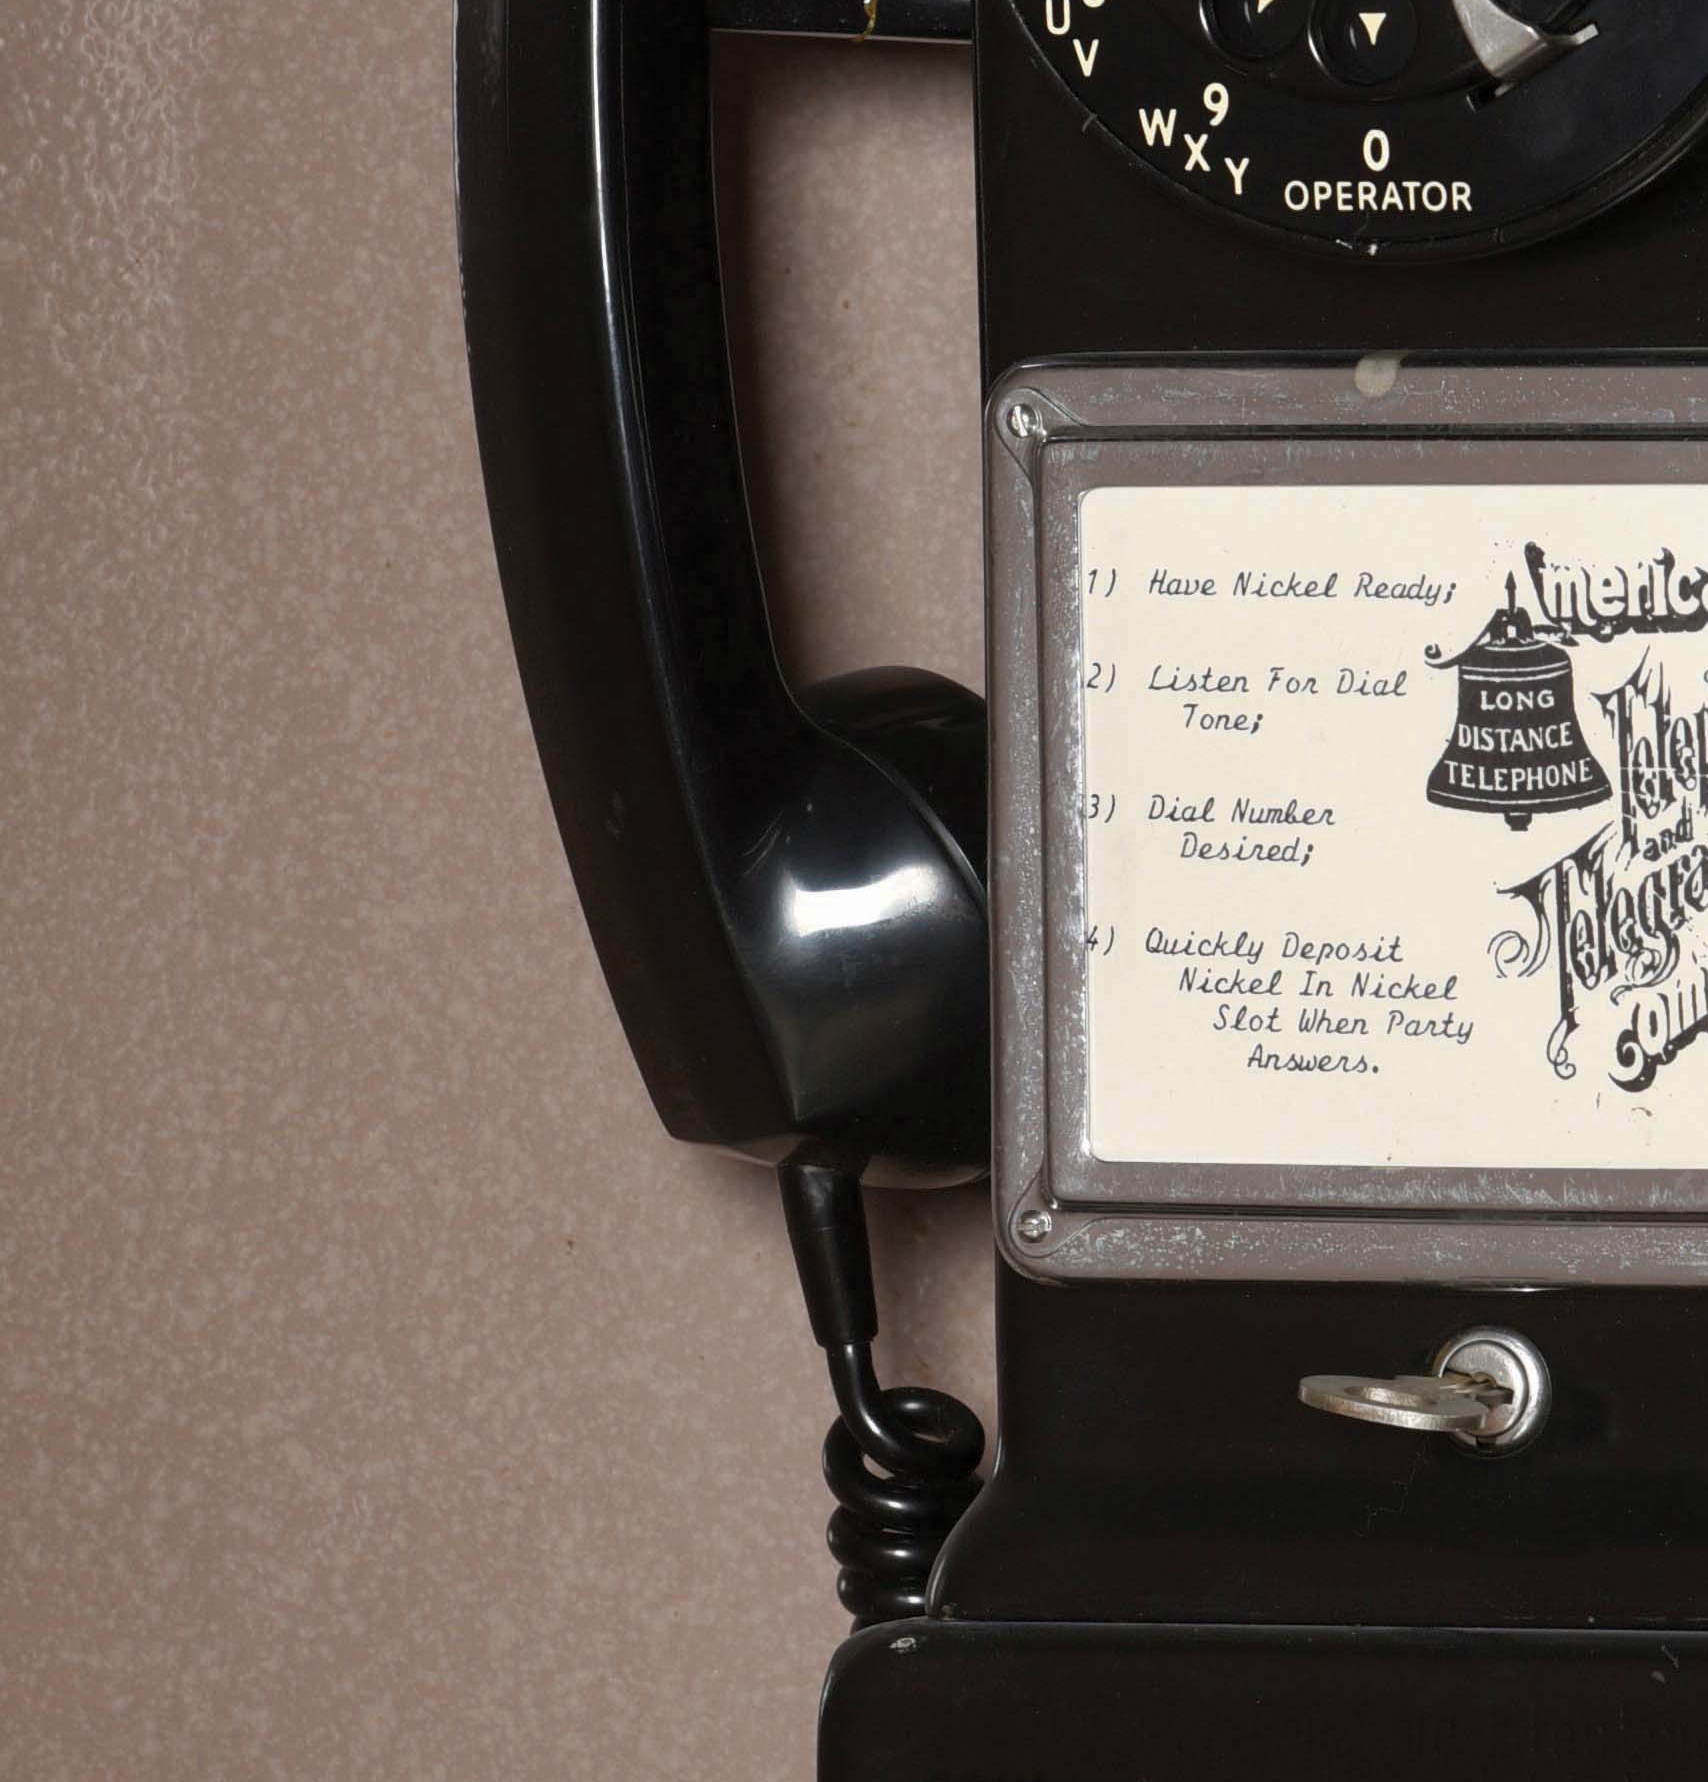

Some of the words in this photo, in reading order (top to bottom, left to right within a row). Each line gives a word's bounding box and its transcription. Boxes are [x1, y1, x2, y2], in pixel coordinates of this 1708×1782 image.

[1203, 82, 1229, 126] 9
[1284, 180, 1473, 212] OPERATOR
[1087, 568, 1117, 598] 1)
[1148, 569, 1217, 596] Have
[1233, 571, 1338, 598] Nickel
[1354, 572, 1458, 607] Ready;
[1086, 662, 1117, 693] 2)
[1148, 665, 1250, 693] Listen
[1267, 667, 1319, 694] For
[1336, 668, 1408, 697] Dial
[1480, 689, 1555, 711] LONG
[1183, 703, 1264, 734] Tone;
[1457, 721, 1574, 753] DISTANCE
[1444, 756, 1594, 793] TELEPHONE
[1087, 793, 1117, 823] 3)
[1148, 794, 1215, 823] Dial
[1231, 797, 1336, 826] Number
[1642, 795, 1694, 862] and
[1180, 831, 1314, 867] Desired;
[1086, 925, 1115, 956] 4)
[1145, 926, 1265, 965] Quickly
[1281, 931, 1404, 966] Deposit
[1179, 967, 1283, 996] Nickel
[1299, 970, 1334, 997] In
[1351, 972, 1459, 1000] Nickel
[1213, 1003, 1283, 1033] Slot
[1298, 1008, 1369, 1035] When
[1387, 1009, 1475, 1045] Party
[1247, 1043, 1380, 1074] Answers.
